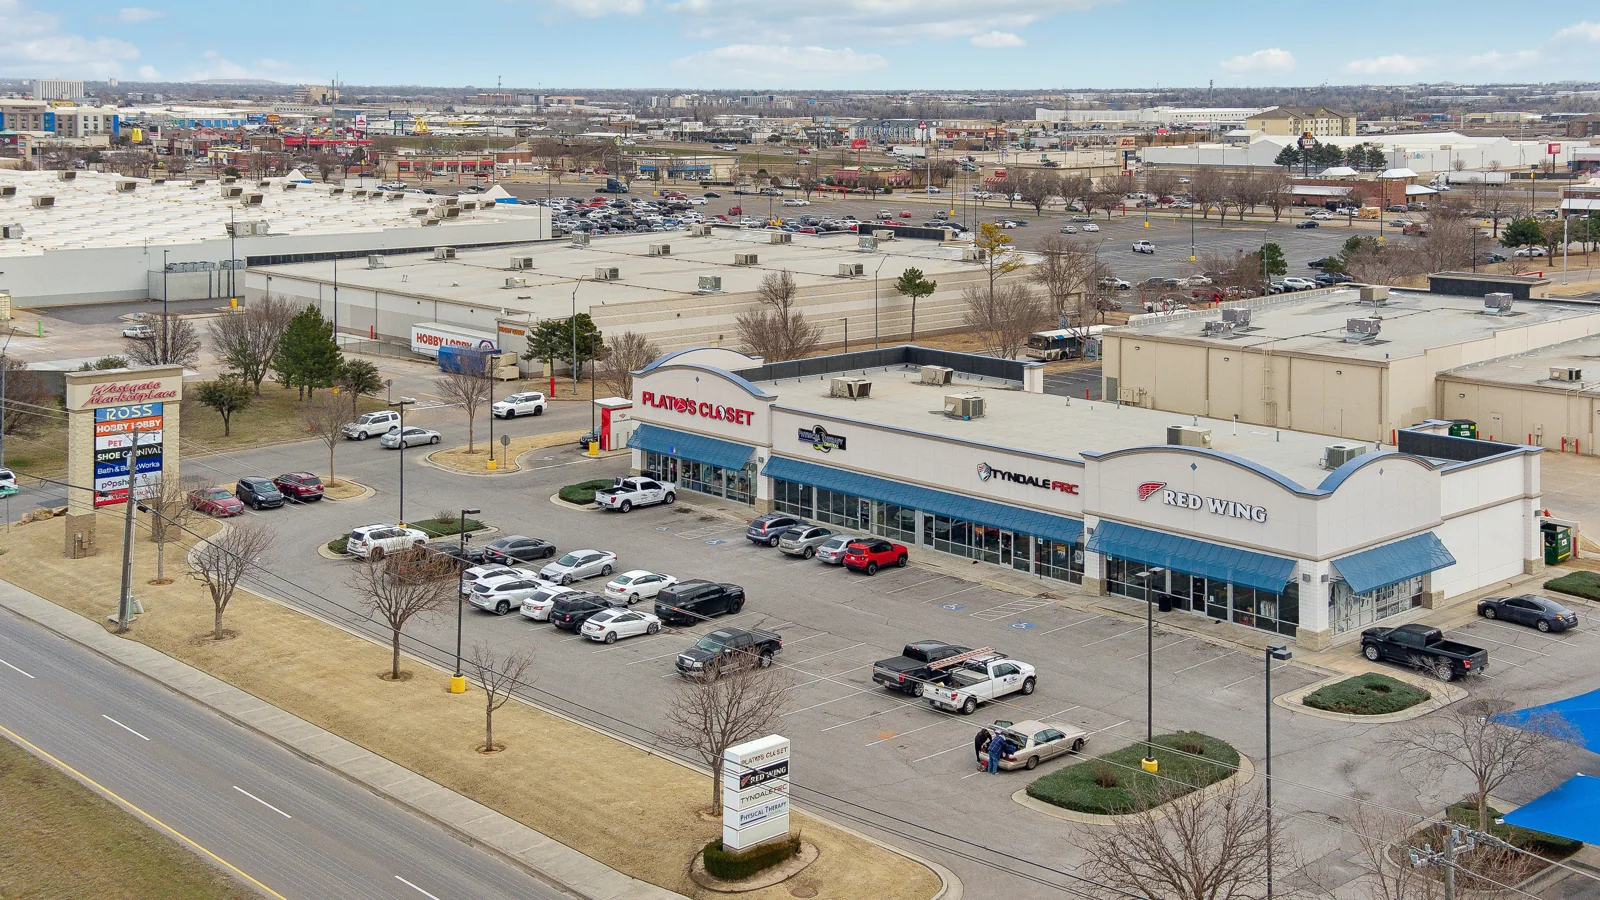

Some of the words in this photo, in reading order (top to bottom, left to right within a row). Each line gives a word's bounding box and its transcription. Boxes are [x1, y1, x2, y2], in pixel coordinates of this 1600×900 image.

[416, 333, 444, 346] HOBBY
[92, 381, 161, 395] Westgate
[81, 390, 177, 407] Marketplace
[106, 404, 153, 420] ROSS
[642, 391, 697, 416] PLATO'S
[699, 402, 754, 426] CLOSET
[96, 422, 129, 433] HOBBY
[97, 451, 121, 461] SHOE
[97, 465, 114, 474] Bath
[139, 461, 160, 470] Works
[991, 469, 1051, 489] TYNDALE
[1051, 481, 1079, 495] FRC
[1162, 489, 1203, 510] RED
[1206, 497, 1267, 523] WING
[750, 774, 764, 783] RED
[766, 767, 786, 778] WING
[741, 788, 774, 804] TYNDALE
[740, 810, 764, 821] PHYSICAL
[765, 801, 786, 813] THERAPY
